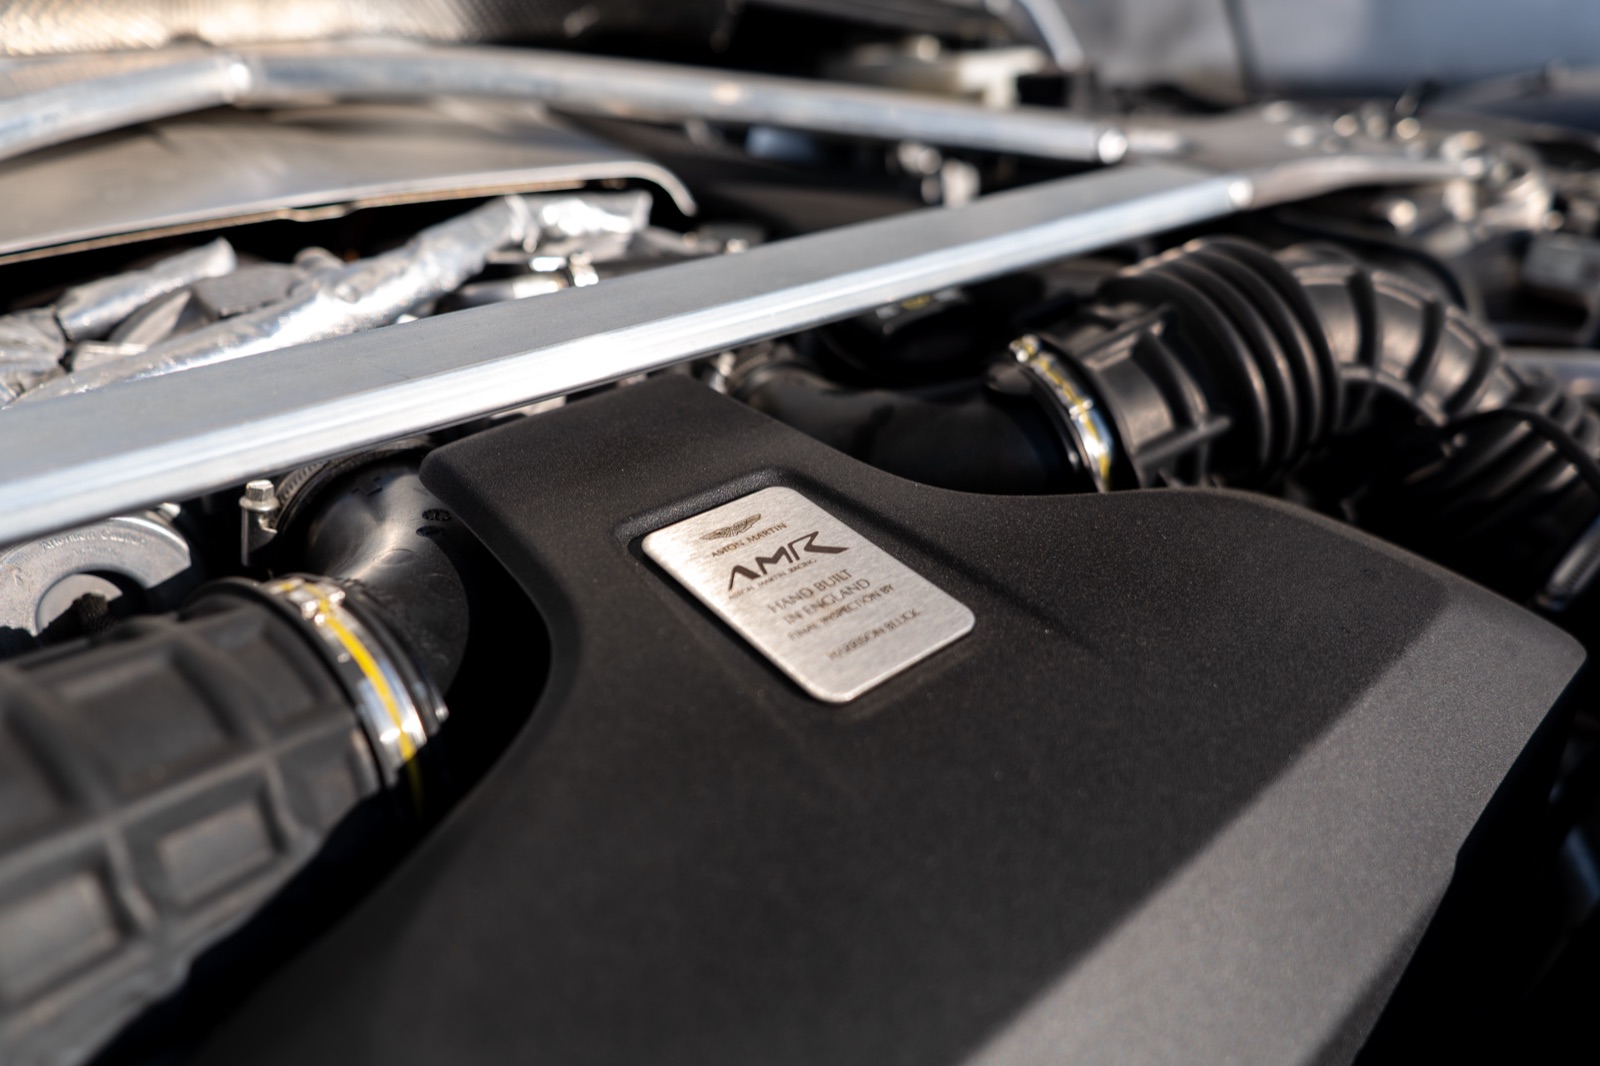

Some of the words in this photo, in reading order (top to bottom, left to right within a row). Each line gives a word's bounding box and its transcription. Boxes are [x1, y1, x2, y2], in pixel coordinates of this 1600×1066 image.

[711, 539, 745, 558] ASTON
[746, 521, 788, 544] MARTIN
[727, 530, 850, 592] AMR
[787, 557, 818, 574] RACING
[766, 587, 815, 613] HAND
[813, 569, 852, 592] BUILT
[783, 608, 803, 625] IN
[802, 578, 870, 616] ENGLAND
[787, 623, 818, 641] FINAL
[820, 590, 881, 624] INSPECTION
[879, 583, 895, 596] BY
